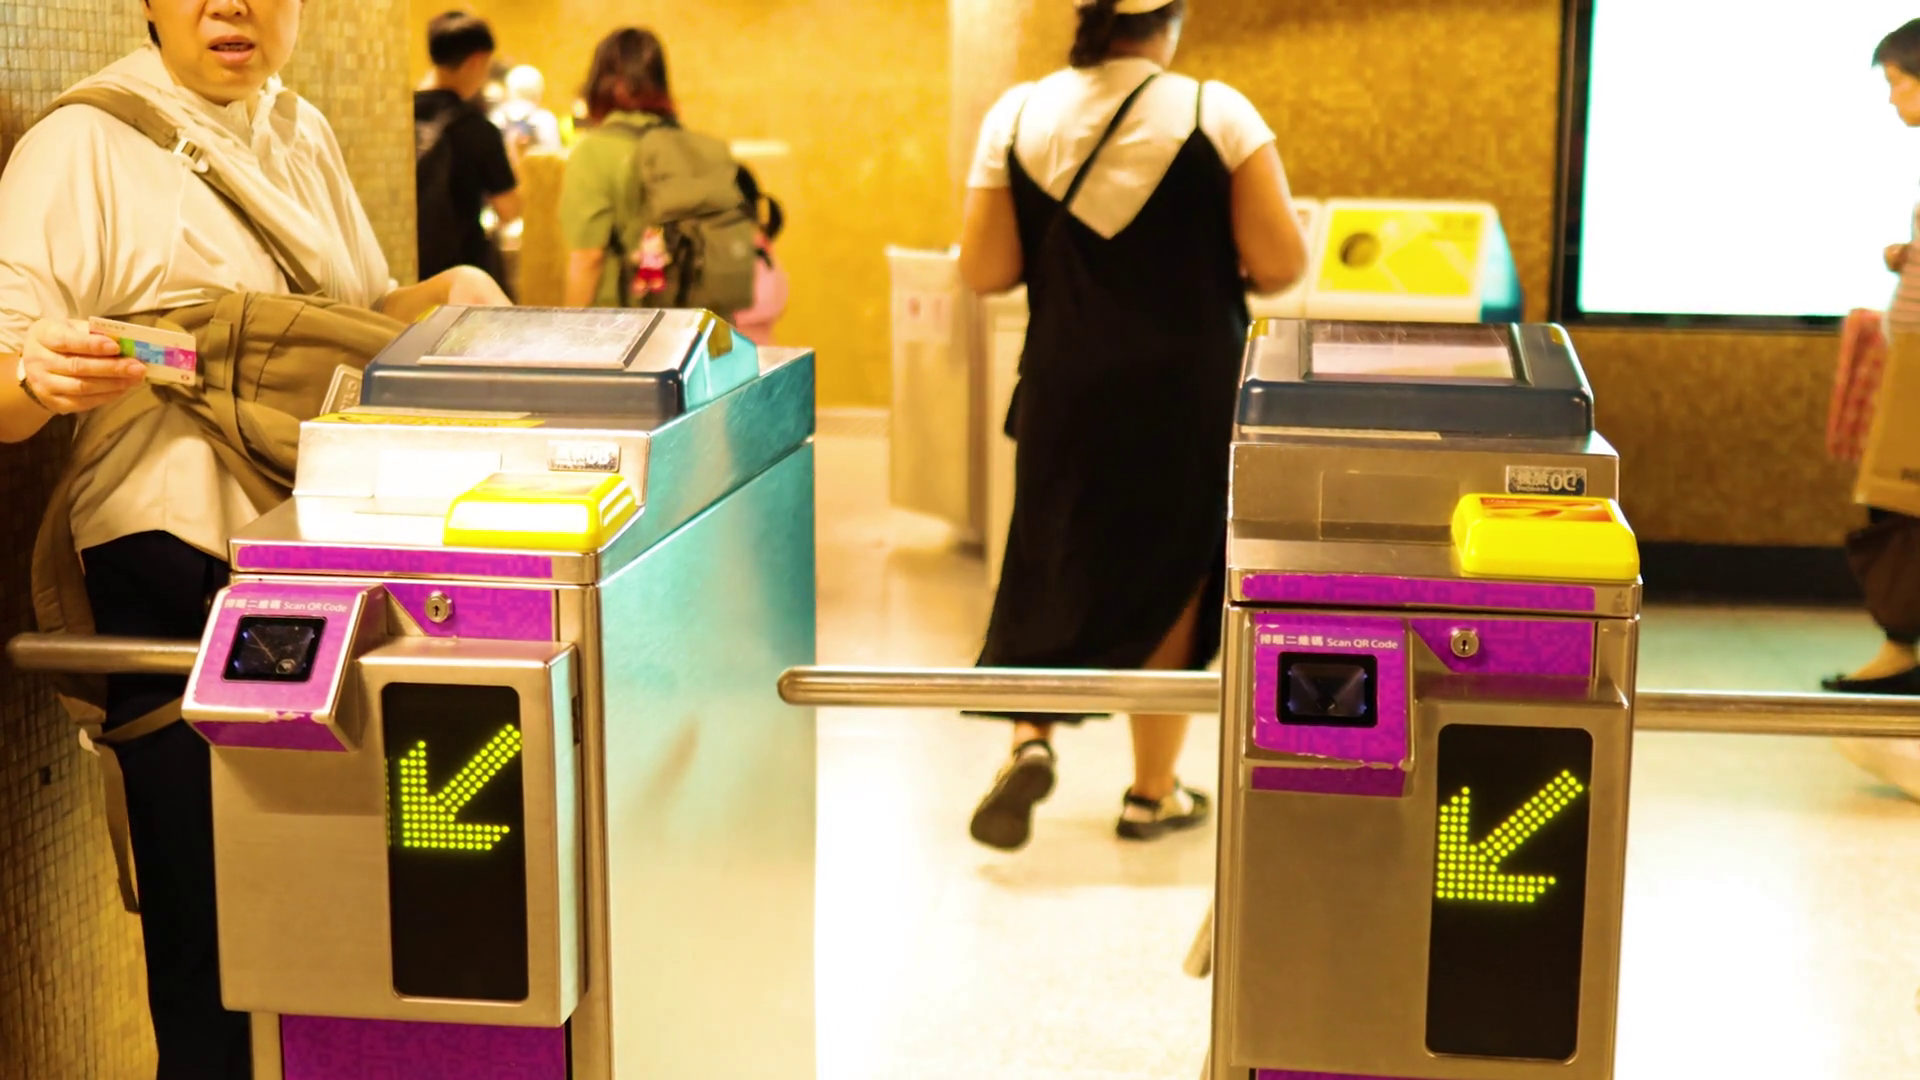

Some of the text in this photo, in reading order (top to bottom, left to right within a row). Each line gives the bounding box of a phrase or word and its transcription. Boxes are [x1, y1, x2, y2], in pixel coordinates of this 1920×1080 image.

[283, 601, 305, 610] Scan
[307, 602, 322, 611] QR
[323, 603, 347, 612] Code
[1327, 638, 1351, 647] Scan
[1353, 638, 1369, 648] QR
[1371, 639, 1398, 649] Code
